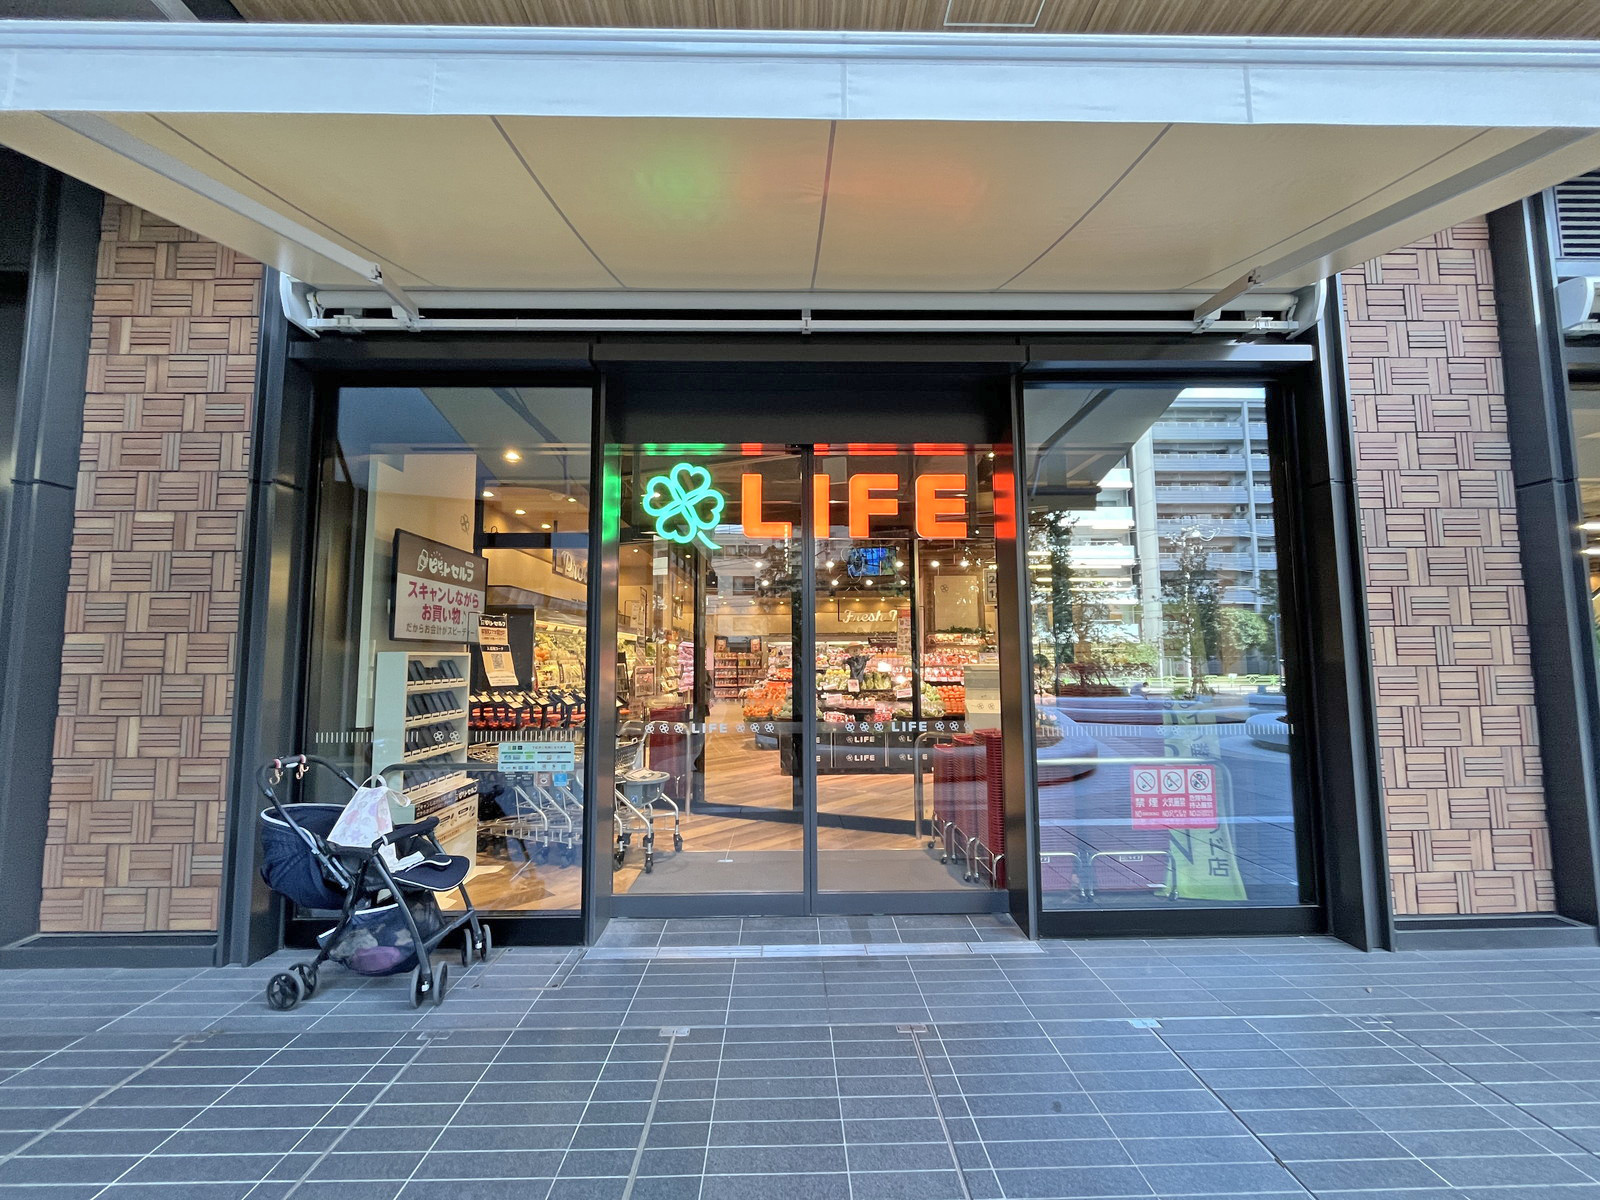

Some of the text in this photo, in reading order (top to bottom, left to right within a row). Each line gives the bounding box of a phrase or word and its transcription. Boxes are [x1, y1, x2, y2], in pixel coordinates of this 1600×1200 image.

[741, 473, 967, 539] LIFE
[408, 580, 479, 608] スキャンしながら
[842, 609, 884, 624] Fresh
[691, 723, 728, 733] LIFE
[891, 721, 928, 732] LIFE
